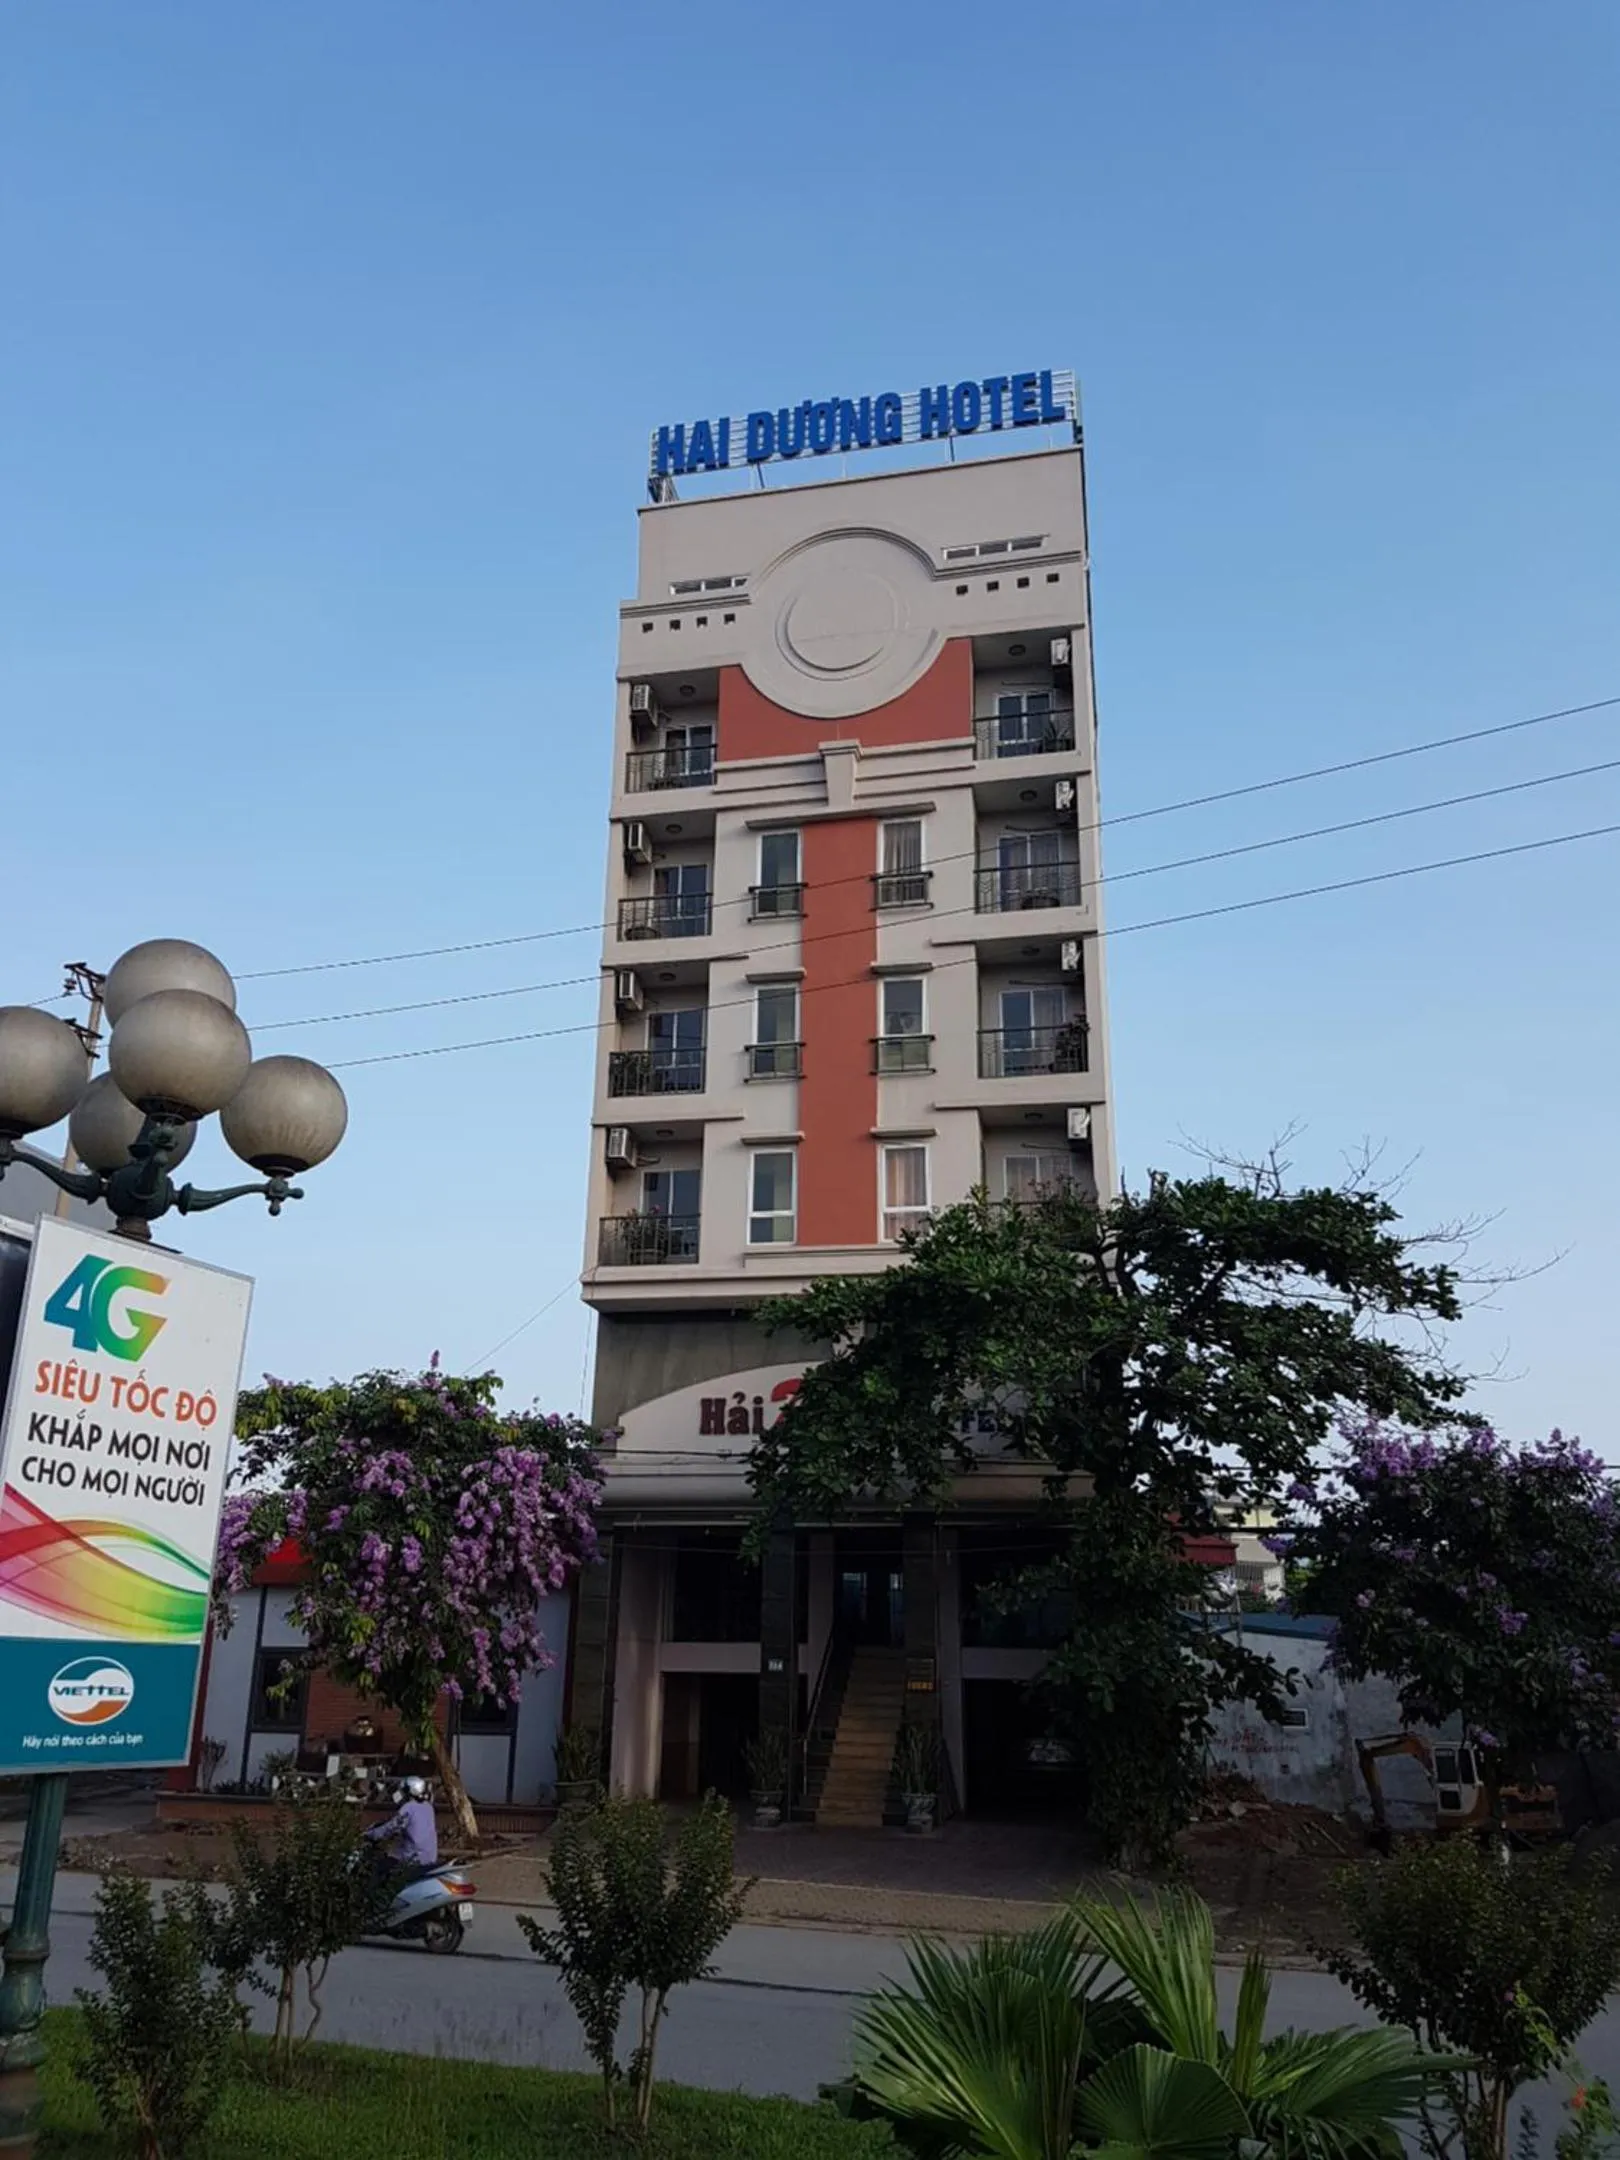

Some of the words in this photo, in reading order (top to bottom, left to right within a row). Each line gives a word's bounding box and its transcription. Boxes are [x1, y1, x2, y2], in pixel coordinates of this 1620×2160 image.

[656, 416, 729, 477] HAI
[747, 392, 902, 463] DƯƠNG
[920, 369, 1066, 438] HOTEL
[43, 1254, 172, 1362] 4G
[35, 1358, 101, 1403] SIÊU
[110, 1369, 169, 1418] TỐC
[175, 1389, 217, 1431] ĐỘ
[699, 1391, 764, 1435] Hải
[28, 1409, 102, 1452] KHẮP
[107, 1429, 160, 1466] MỌI
[165, 1439, 211, 1471] NƠI
[21, 1456, 76, 1487] CHO
[81, 1467, 129, 1498] MỌI
[134, 1474, 205, 1506] NGƯỜI
[61, 1735, 84, 1747] theo
